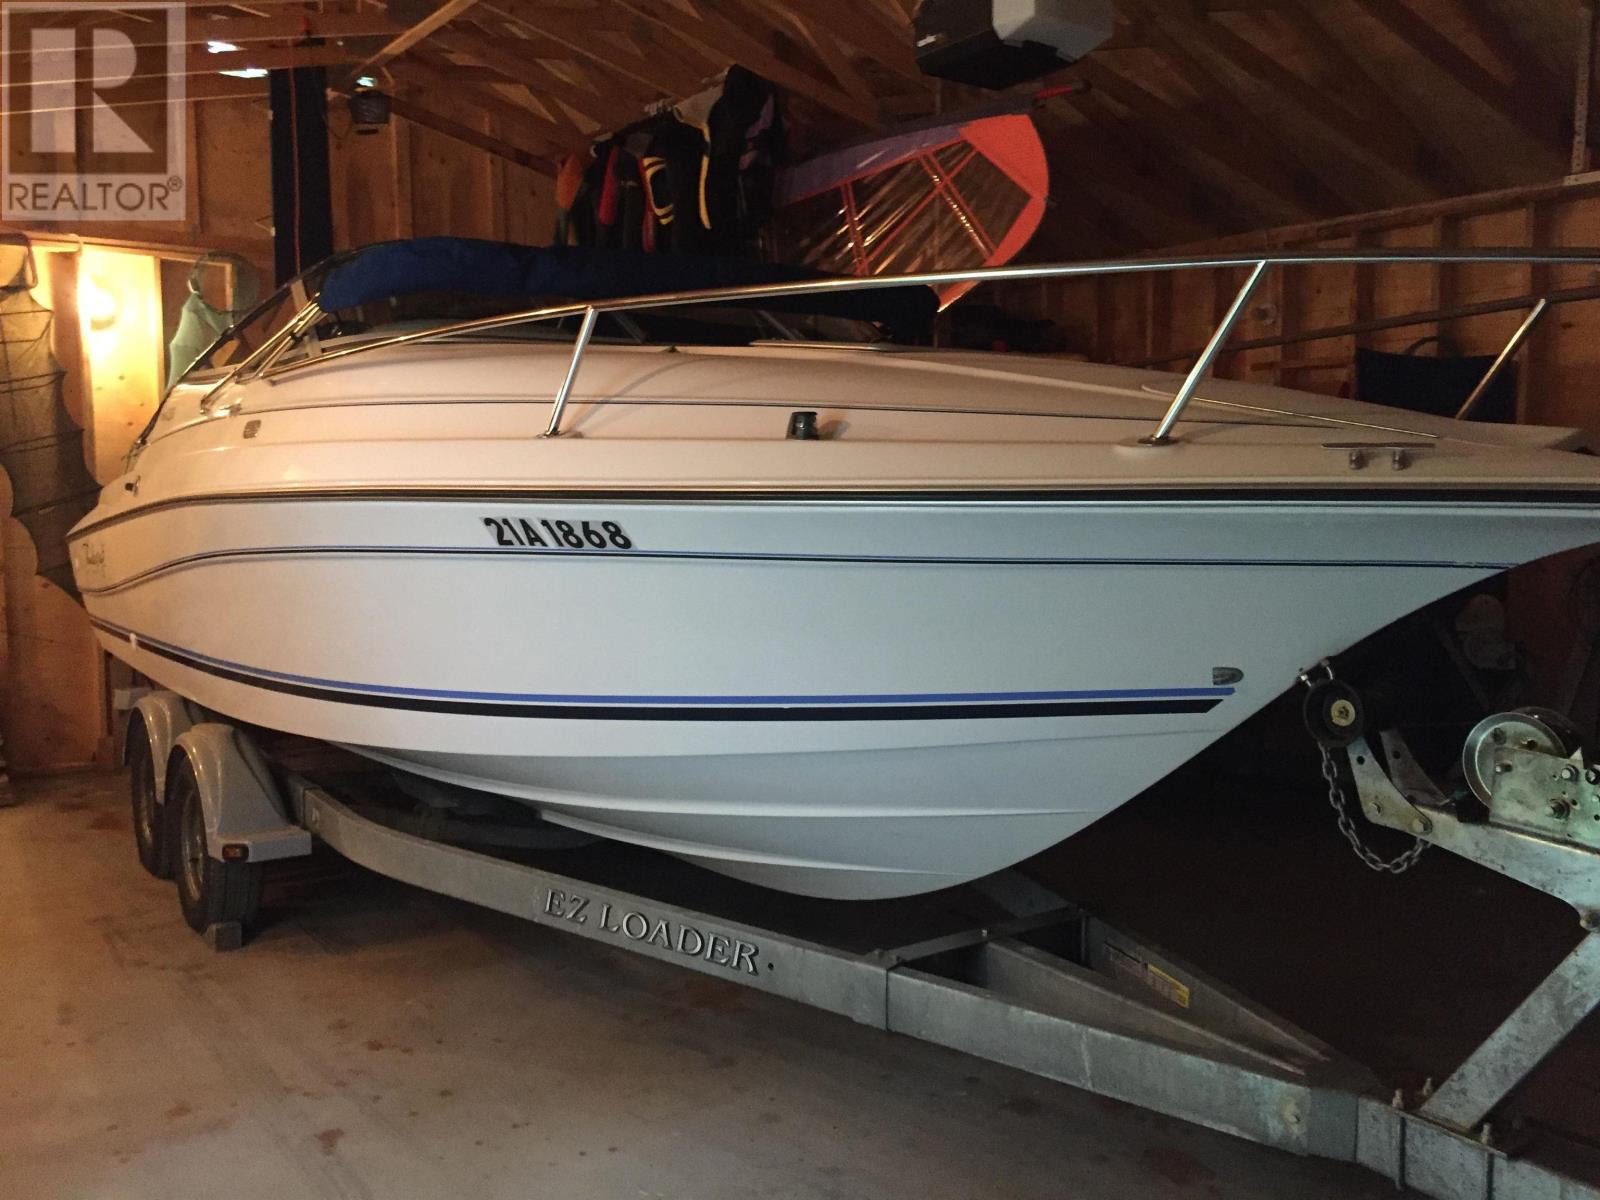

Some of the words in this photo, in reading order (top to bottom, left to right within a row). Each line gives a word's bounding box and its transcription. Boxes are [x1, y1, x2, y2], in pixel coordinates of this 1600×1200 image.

[484, 517, 632, 549] 21A1868
[543, 888, 590, 923] EZ
[600, 902, 760, 976] LOADER
